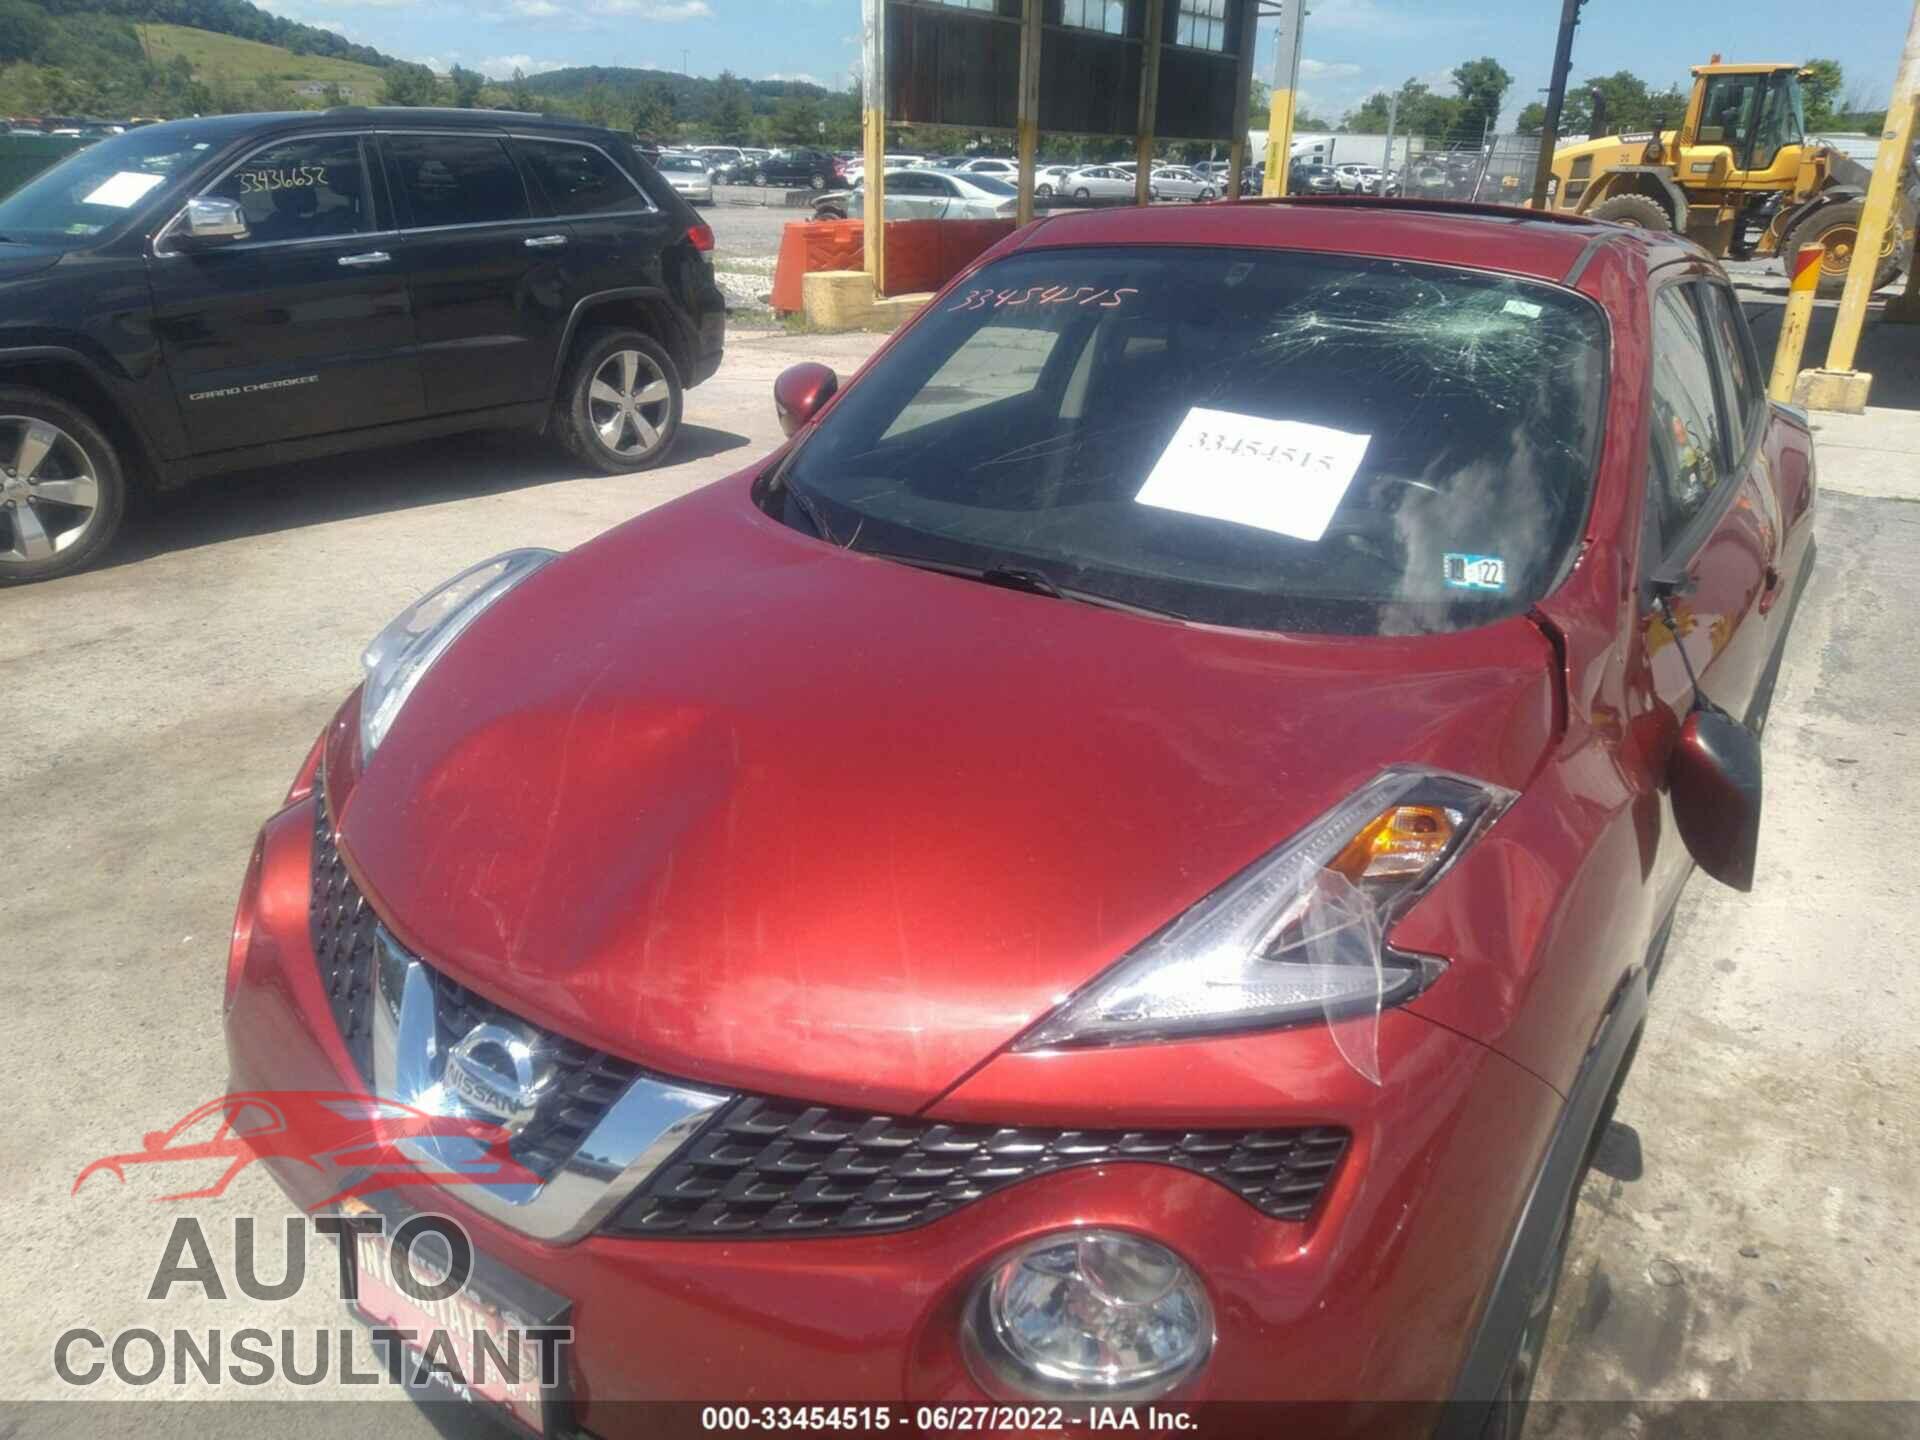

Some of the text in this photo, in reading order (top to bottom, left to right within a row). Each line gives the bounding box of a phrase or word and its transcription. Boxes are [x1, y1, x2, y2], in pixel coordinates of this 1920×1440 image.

[235, 167, 329, 194] 33436652
[947, 286, 1139, 312] 33454515
[189, 374, 320, 400] GRAND CHEROKEE
[449, 1062, 524, 1115] NISSAN
